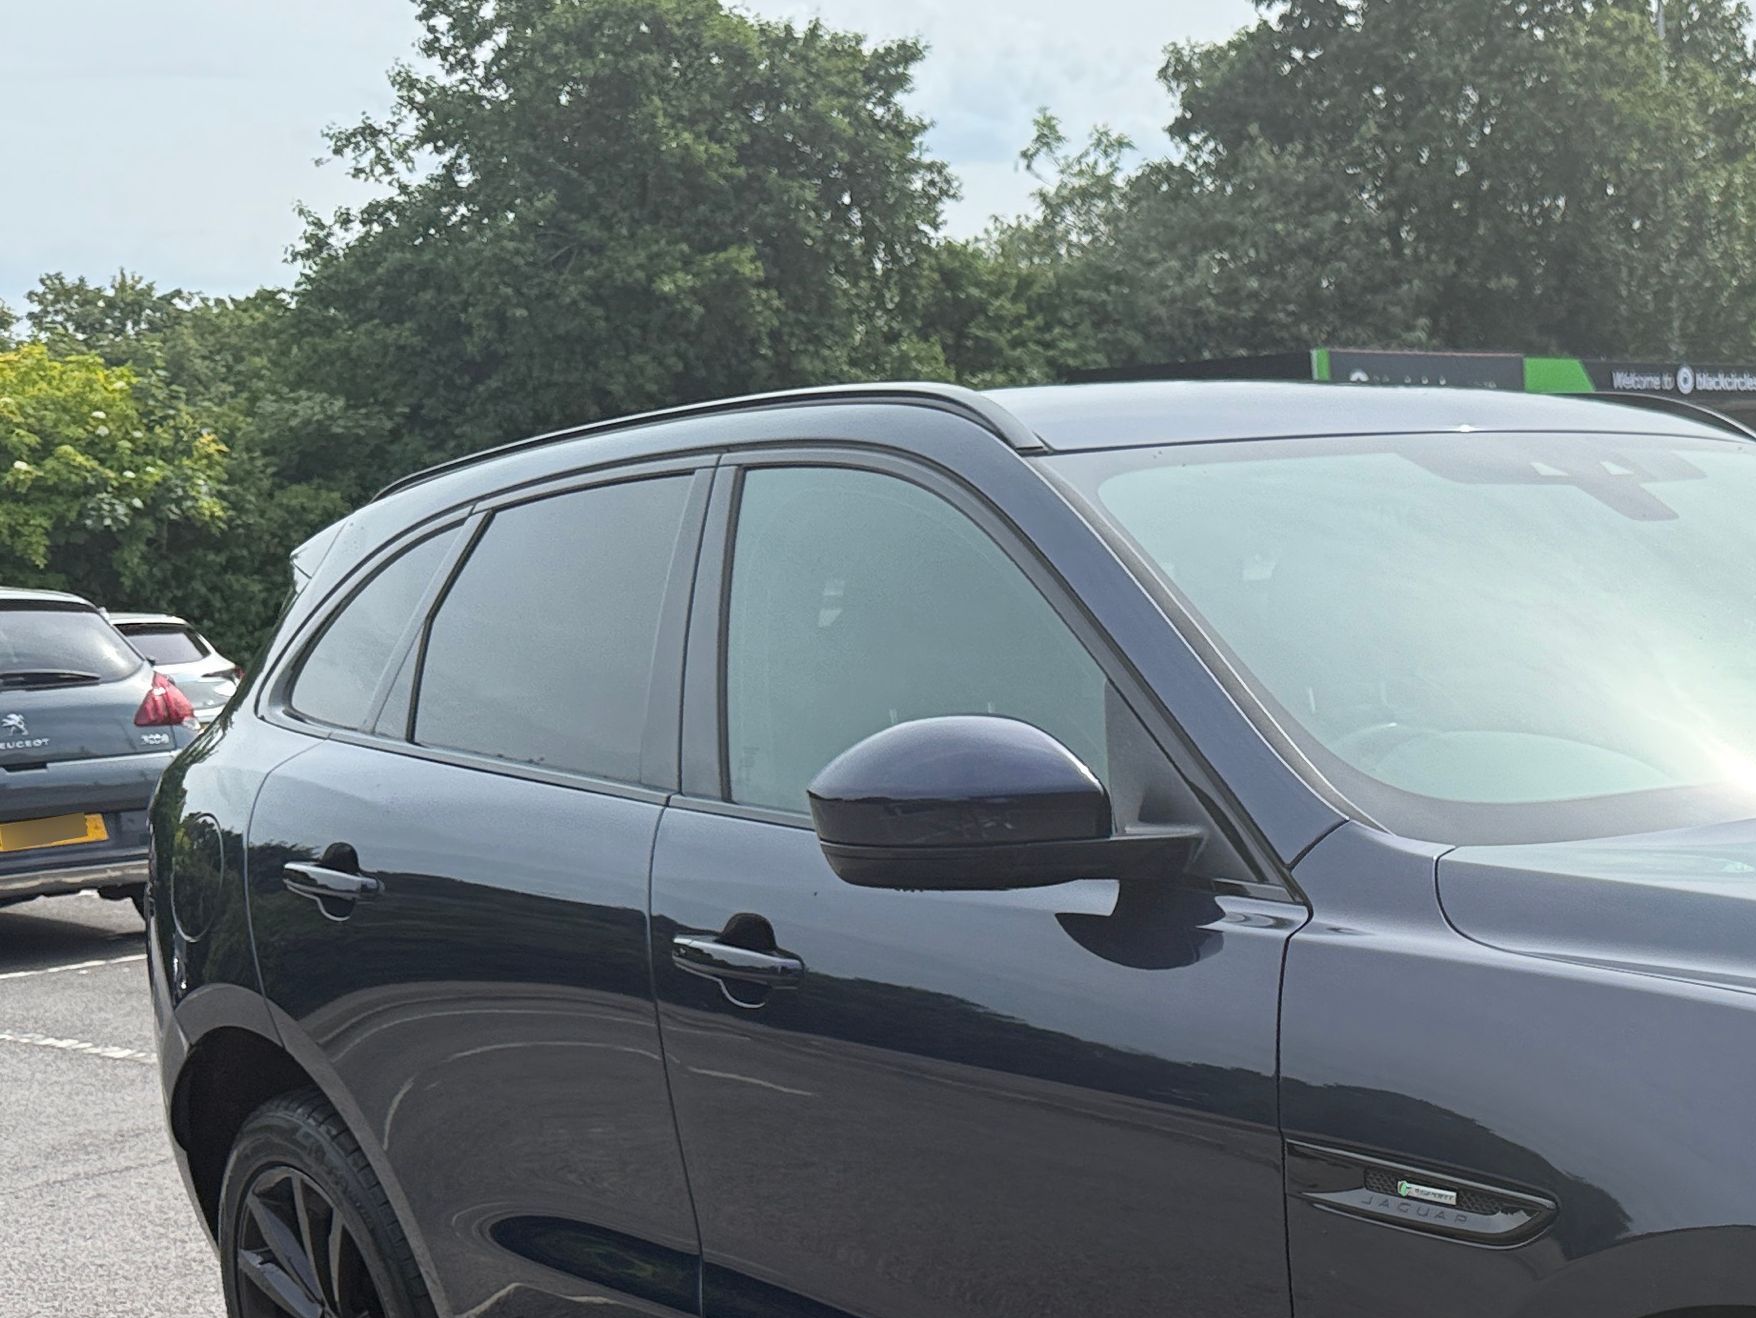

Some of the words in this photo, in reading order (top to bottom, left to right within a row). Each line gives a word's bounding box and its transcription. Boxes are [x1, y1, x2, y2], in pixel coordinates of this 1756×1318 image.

[1612, 371, 1661, 390] Welcome
[1662, 373, 1674, 390] to
[0, 738, 50, 750] EUGEOT
[1360, 1196, 1469, 1224] JAGUAR
